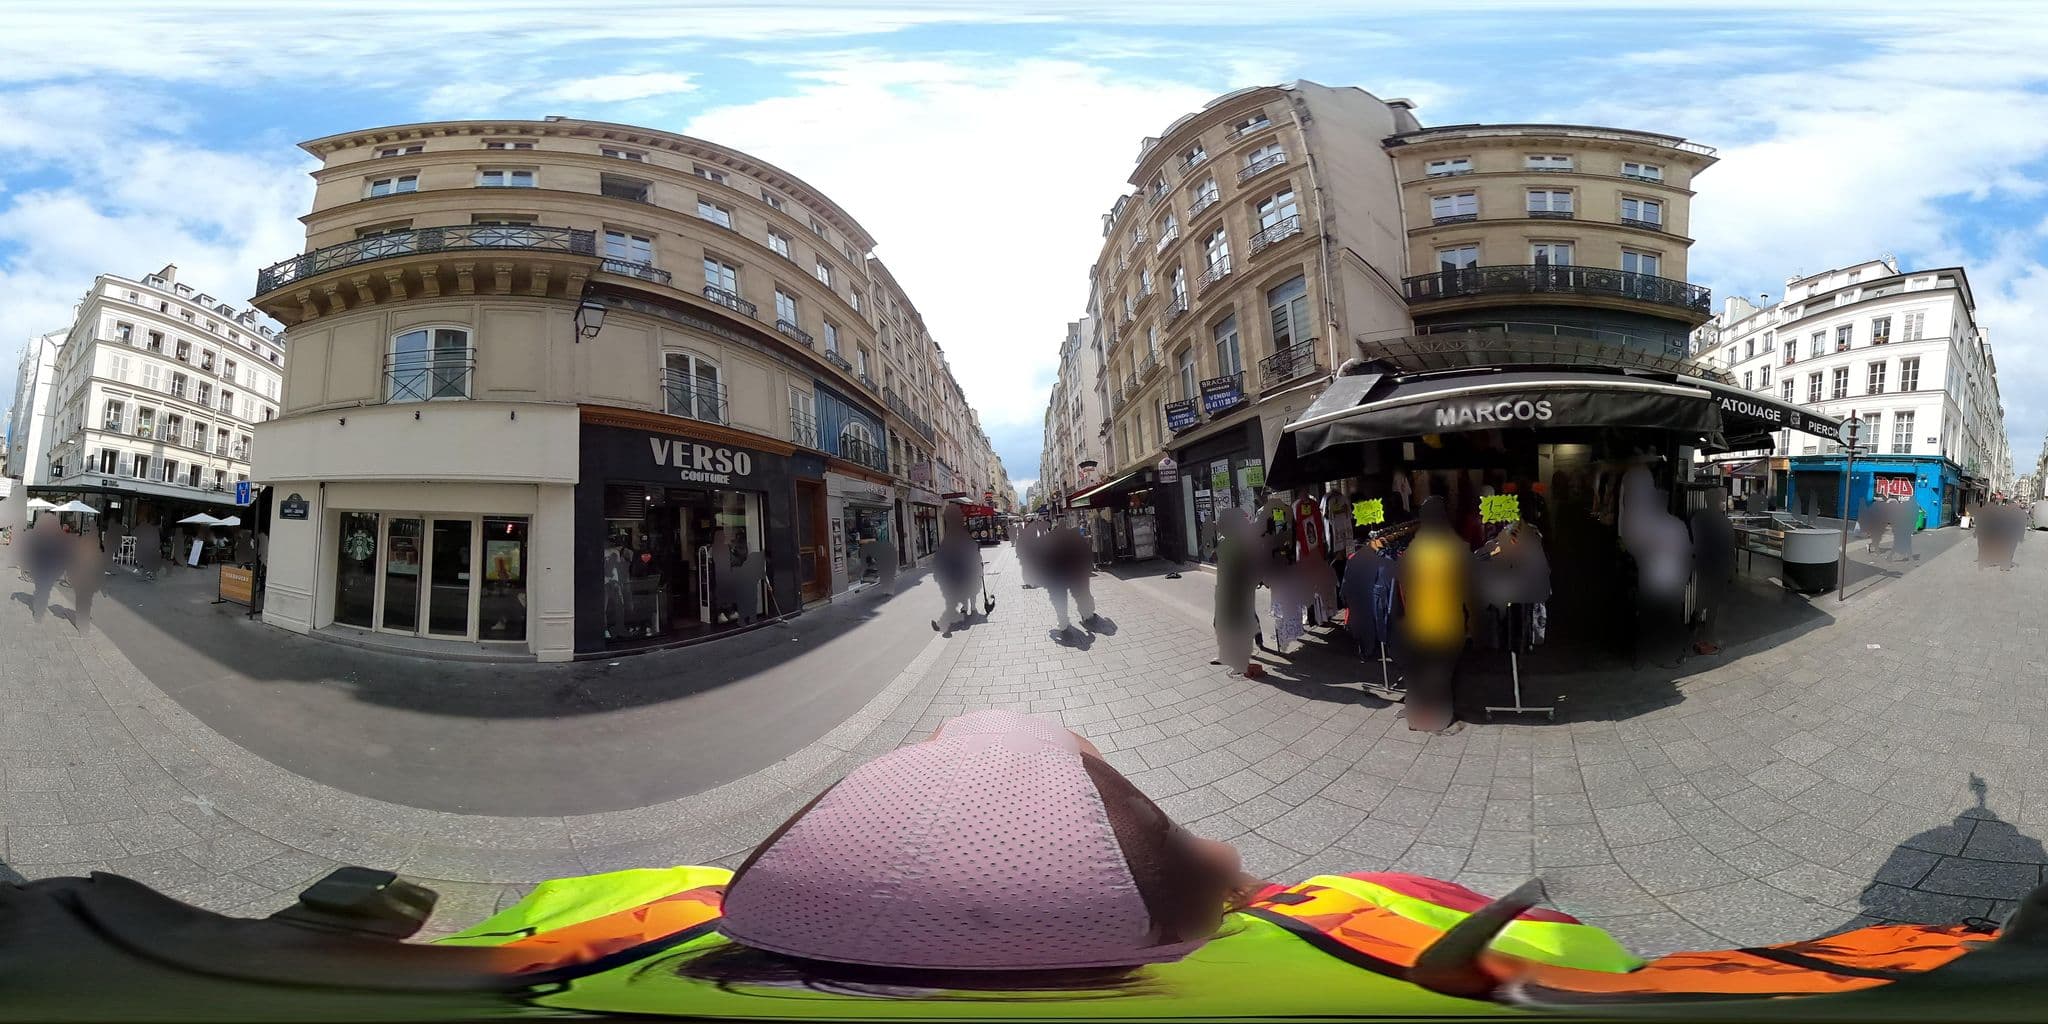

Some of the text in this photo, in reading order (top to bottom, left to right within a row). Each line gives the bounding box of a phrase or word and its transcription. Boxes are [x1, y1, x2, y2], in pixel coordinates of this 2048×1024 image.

[1209, 391, 1231, 401] VENDU
[1436, 400, 1553, 426] MARCOS
[650, 437, 752, 476] VERSO
[681, 469, 730, 485] COUTURE
